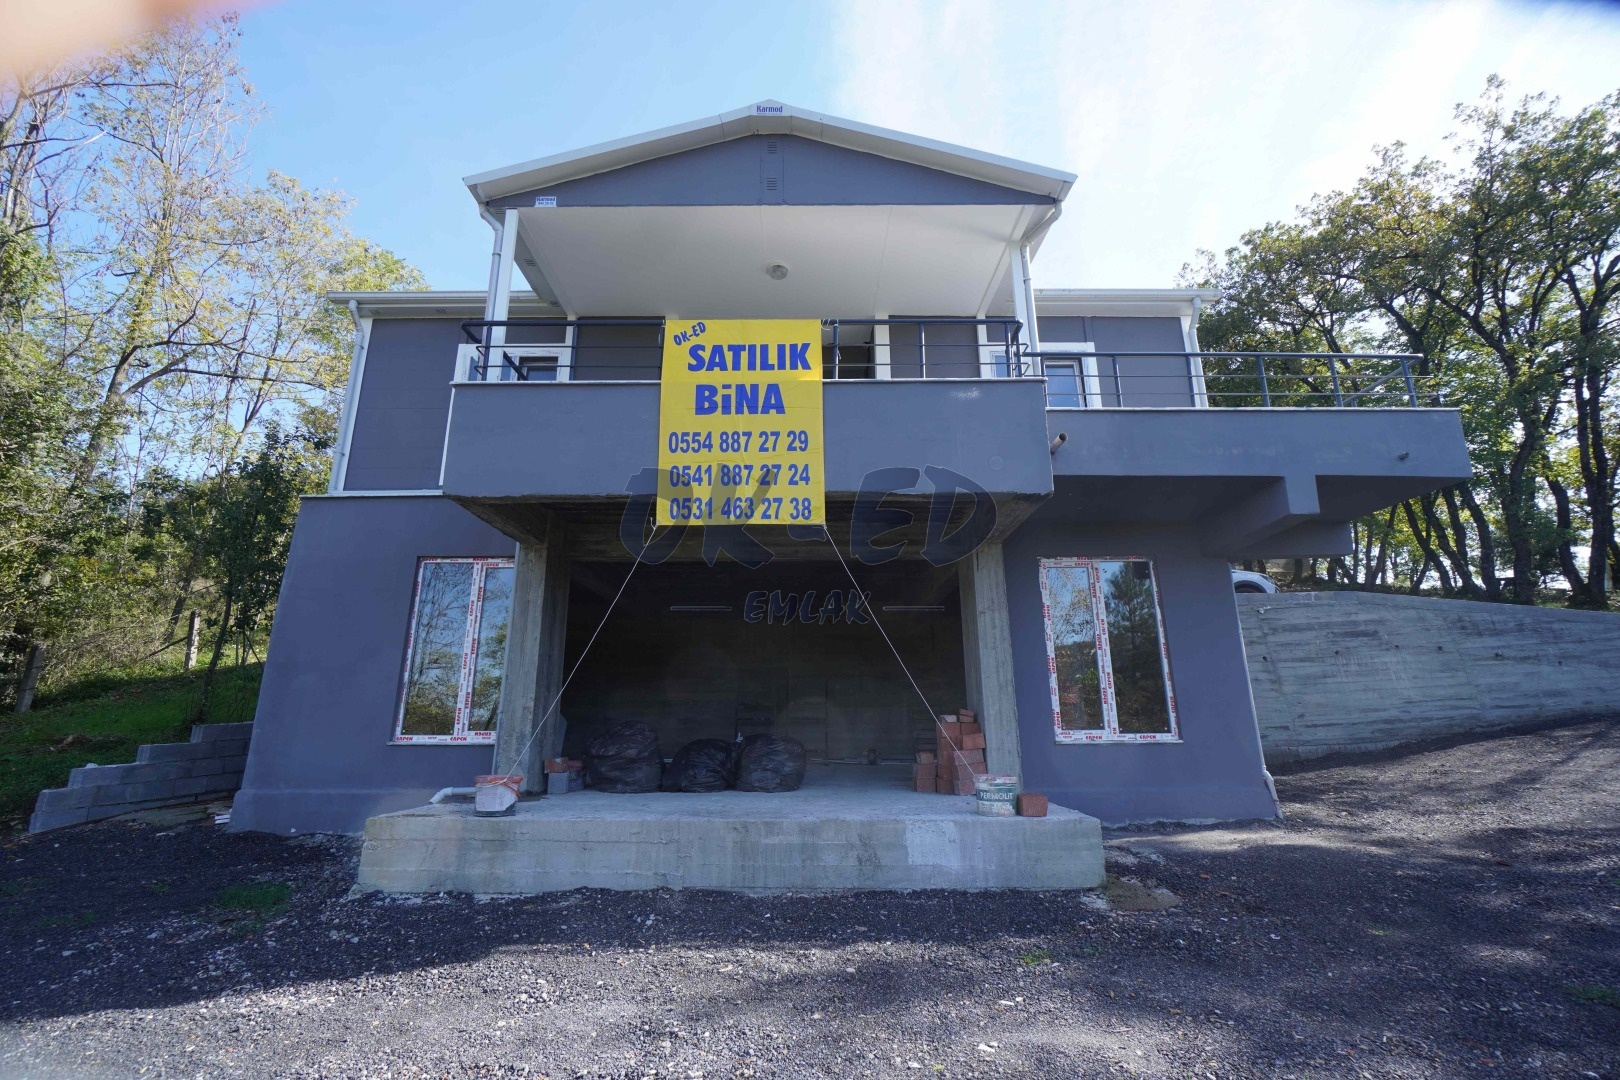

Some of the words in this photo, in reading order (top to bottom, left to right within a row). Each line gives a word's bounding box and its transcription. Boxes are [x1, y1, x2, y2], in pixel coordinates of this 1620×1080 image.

[756, 105, 783, 113] Karmod
[673, 321, 707, 346] OK-ED
[687, 343, 812, 372] SATILIK
[668, 431, 713, 453] 0554
[719, 431, 752, 453] 887
[758, 431, 780, 452] 27
[786, 430, 808, 452] 29
[669, 465, 713, 487] 0541
[720, 464, 754, 486] 887
[759, 464, 782, 486] 27
[787, 464, 810, 485] 24
[669, 498, 713, 520] 0531
[720, 497, 754, 520] 463
[760, 497, 783, 520] 27
[789, 497, 812, 520] 38
